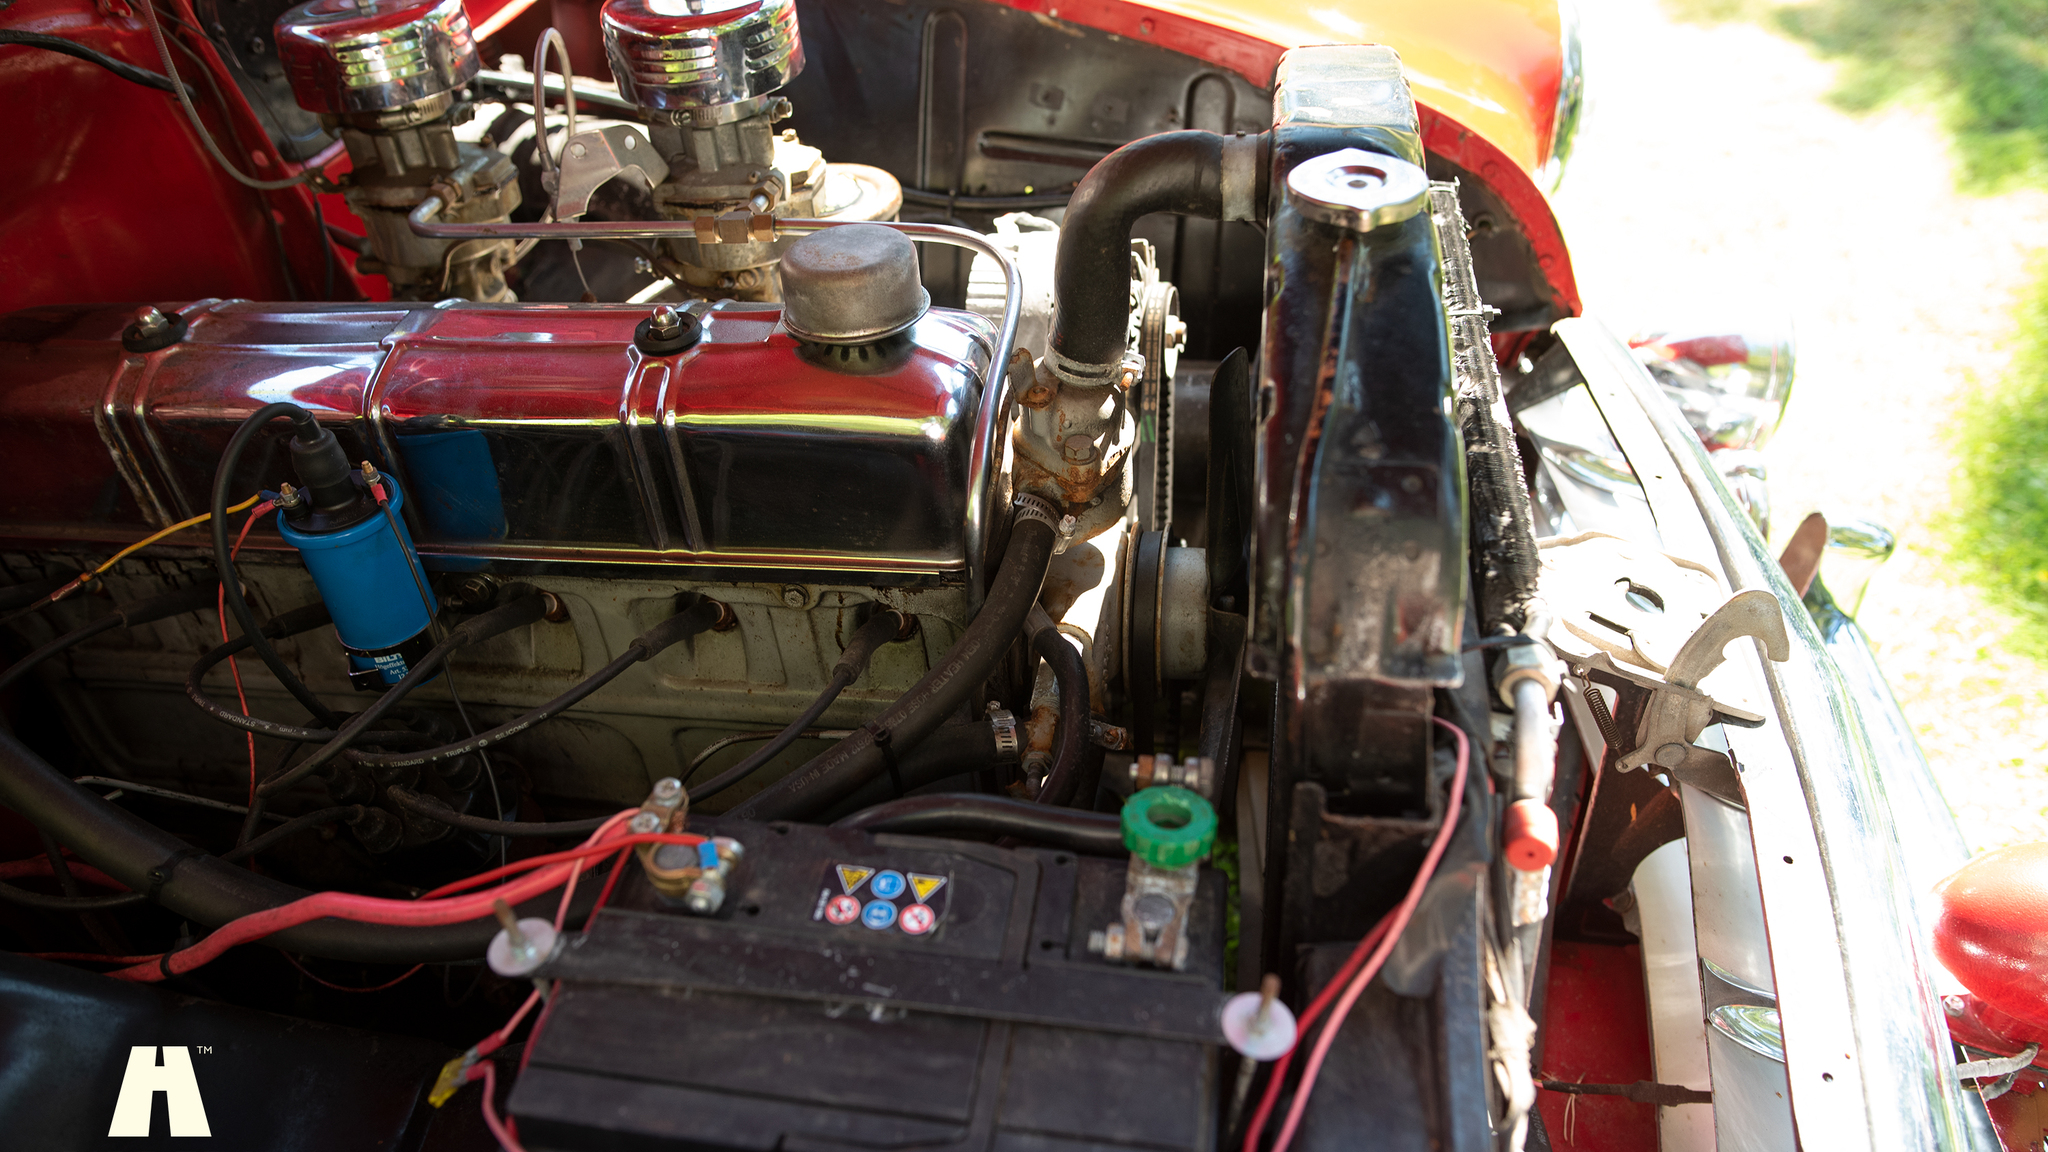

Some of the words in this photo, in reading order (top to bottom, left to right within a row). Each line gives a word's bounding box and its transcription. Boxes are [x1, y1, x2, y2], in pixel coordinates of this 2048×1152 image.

[962, 639, 981, 661] OEM
[390, 668, 402, 676] Art.
[929, 660, 964, 694] HEATER
[908, 691, 930, 714] HOSE
[219, 710, 256, 728] STANDARD
[390, 758, 425, 768] STANDARD
[445, 745, 471, 758] TRIPLE
[494, 721, 529, 741] SILICONE
[822, 752, 850, 774] MADE
[788, 776, 810, 792] USA
[810, 769, 821, 780] IN
